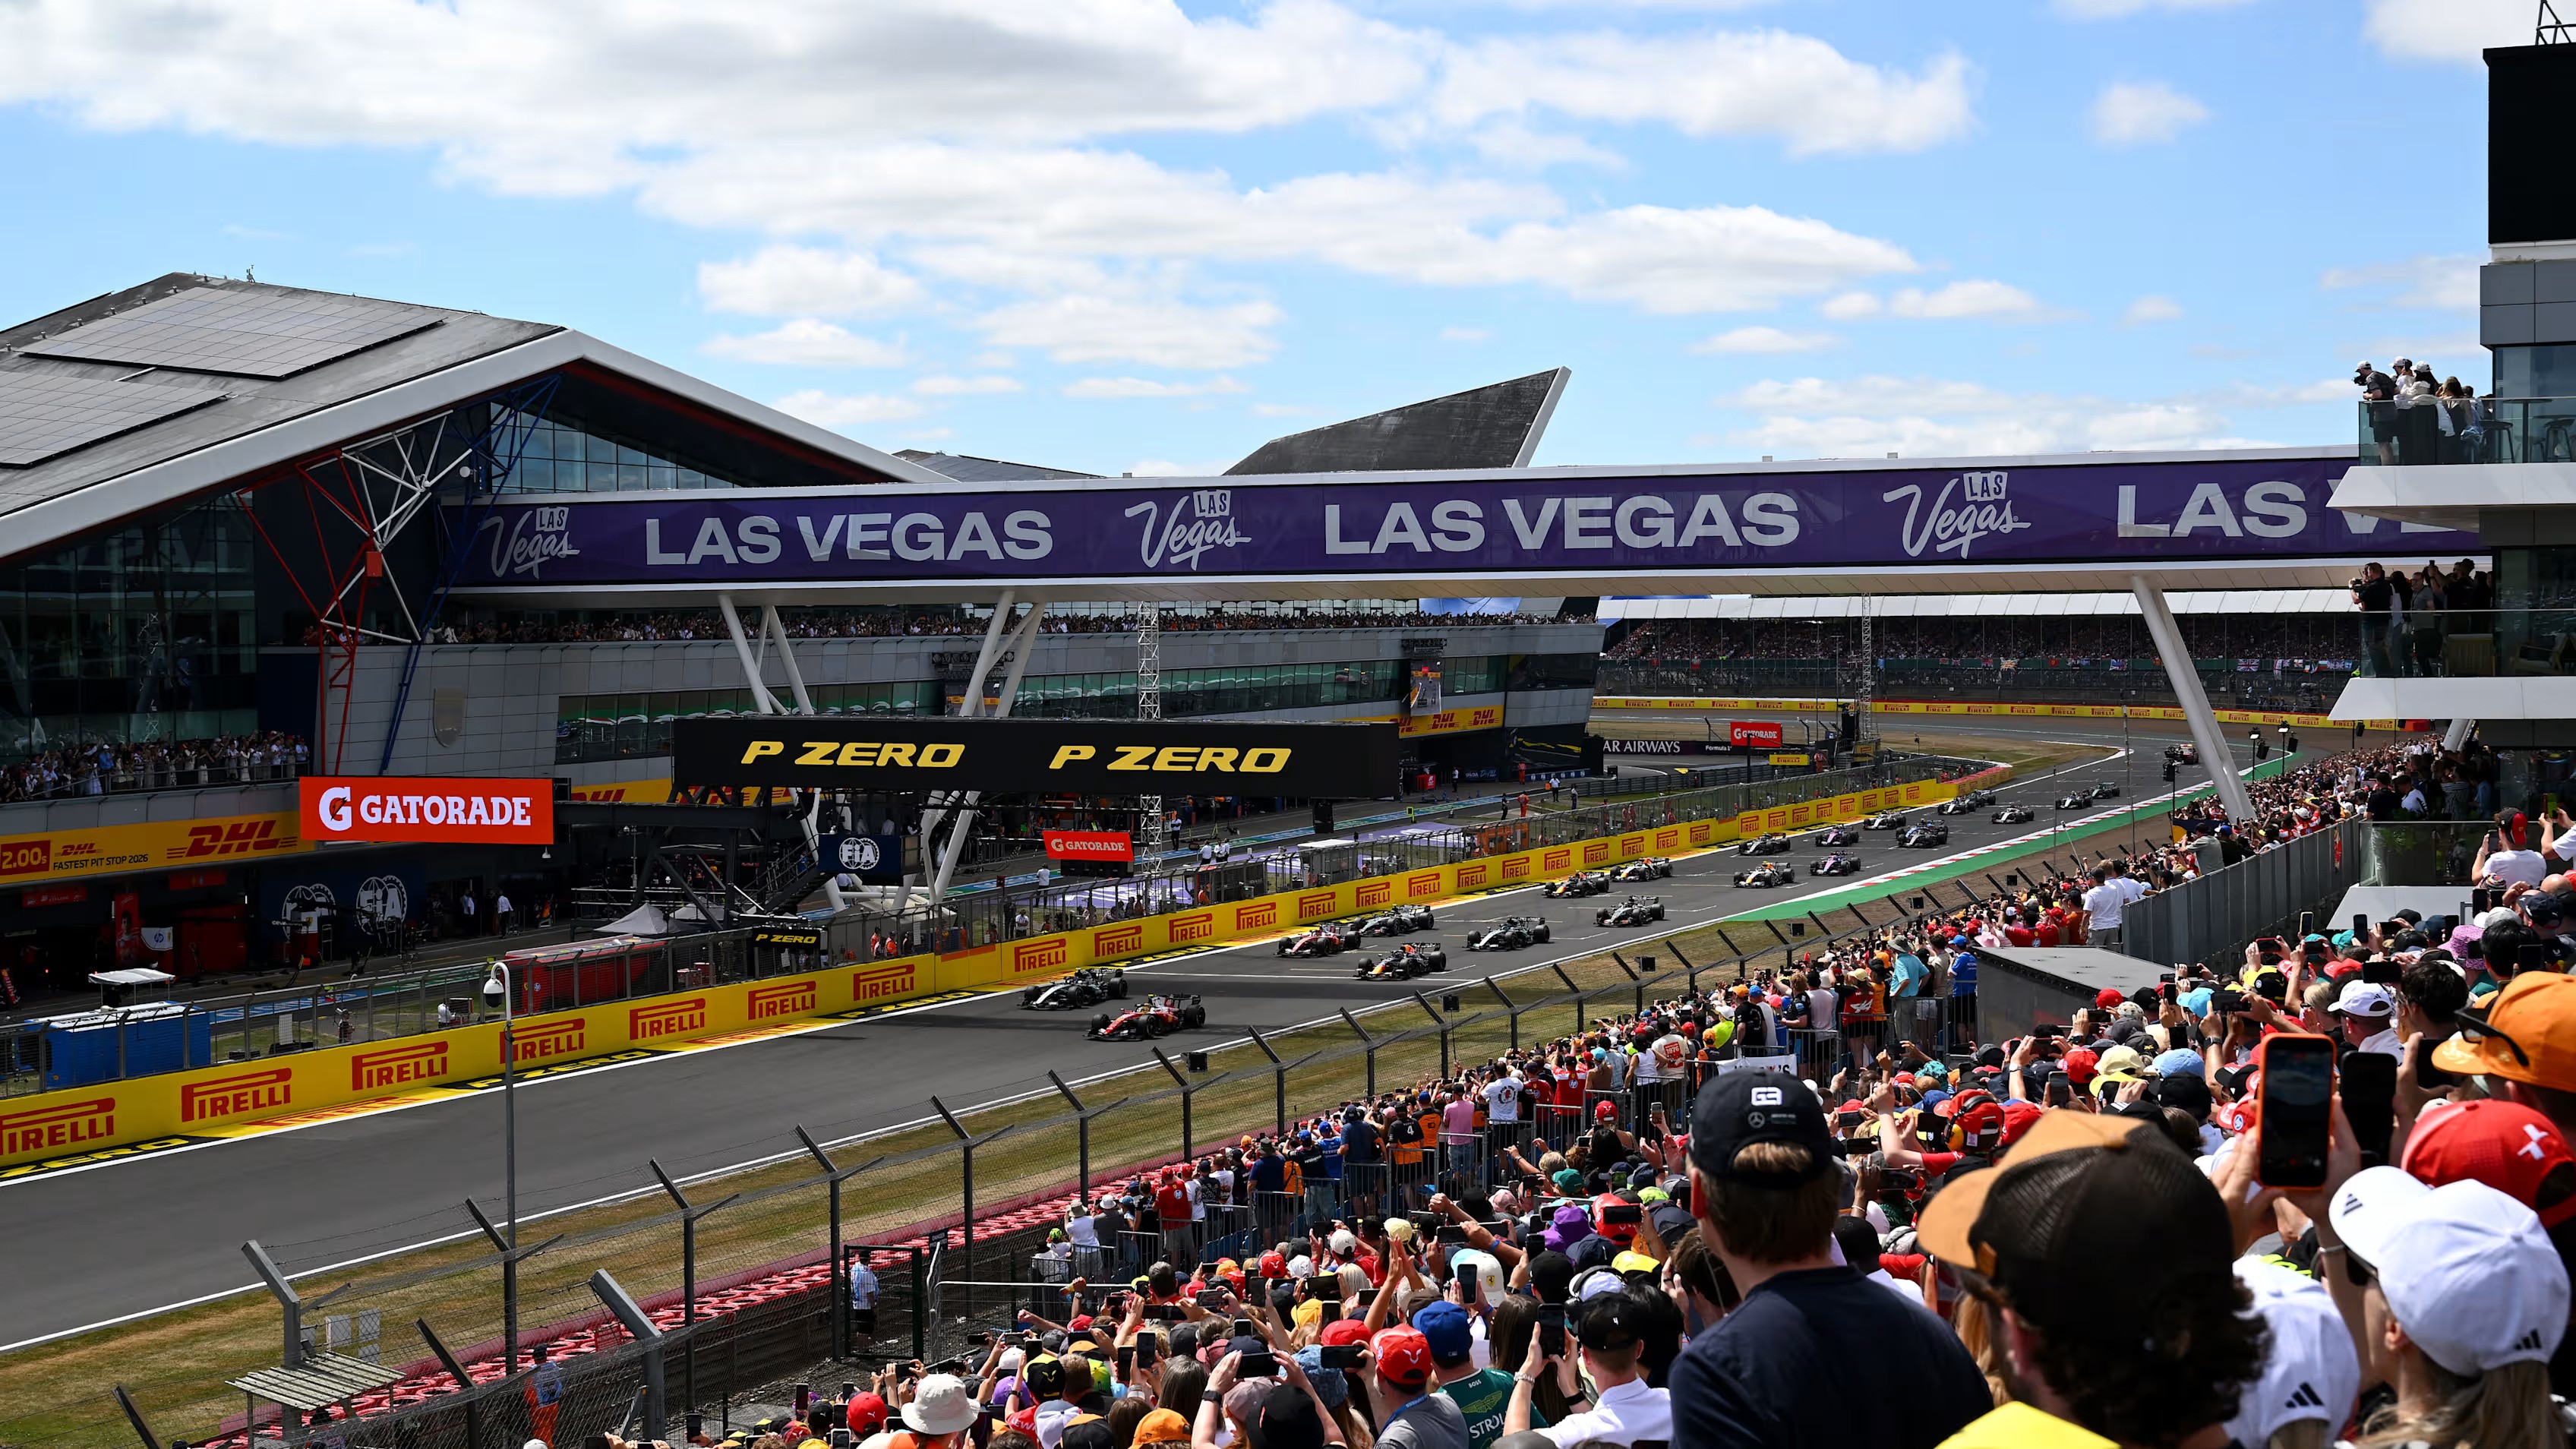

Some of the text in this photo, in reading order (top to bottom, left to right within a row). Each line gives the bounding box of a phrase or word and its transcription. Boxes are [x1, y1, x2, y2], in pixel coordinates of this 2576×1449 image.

[1965, 472, 2006, 500] LAS
[1197, 491, 1229, 514] LAS
[2118, 481, 2308, 538] LAS
[538, 509, 564, 529] LAS
[1325, 492, 1800, 554] LAS VEGAS
[1883, 478, 2031, 558] Vegas
[481, 510, 580, 579] Vegas
[646, 510, 1053, 565] LAS VEGAS
[1124, 496, 1252, 571] Vegas
[1432, 713, 1456, 729] DHL
[1473, 709, 1495, 725] DHL
[741, 741, 965, 768] P ZERO
[1049, 745, 1292, 772] P ZERO
[1624, 740, 1681, 753] AIRWAYS
[319, 787, 532, 831] G GATORADE
[1768, 811, 1786, 829] PIRELLI
[1690, 825, 1710, 844] PIRELLI
[1741, 815, 1759, 833] PIRELLI
[61, 843, 97, 857] DHL
[185, 820, 279, 857] DHL
[1051, 838, 1125, 851] G GATORADE
[1622, 836, 1644, 857] PIRELLI
[1657, 830, 1678, 850] PIRELLI
[2, 848, 47, 870] 2.00s
[53, 854, 148, 870] FASTEST PIT STOP 2026
[1545, 849, 1571, 871] PIRELLI
[1584, 843, 1608, 863] PIRELLI
[1457, 865, 1486, 888] PIRELLI
[1502, 857, 1530, 879] PIRELLI
[1356, 882, 1391, 908] PIRELLI
[1409, 873, 1440, 897] PIRELLI
[1236, 902, 1276, 930] PIRELLI
[1299, 892, 1336, 918] PIRELLI
[770, 935, 817, 944] ZERO
[1170, 913, 1212, 942] PIRELLI
[1094, 926, 1141, 957] PIRELLI
[1015, 938, 1066, 972] PIRELLI
[854, 964, 914, 1001] PIRELLI
[748, 980, 816, 1020] PIRELLI
[630, 998, 706, 1040] PIRELLI
[500, 1018, 586, 1064] PIRELLI
[352, 1040, 448, 1091] PIRELLI
[182, 1067, 292, 1123] PIRELLI
[0, 1097, 115, 1155] PIRELLI
[1407, 1125, 1414, 1135] 4
[1469, 1379, 1482, 1388] BOSS
[1470, 1412, 1504, 1438] STROL
